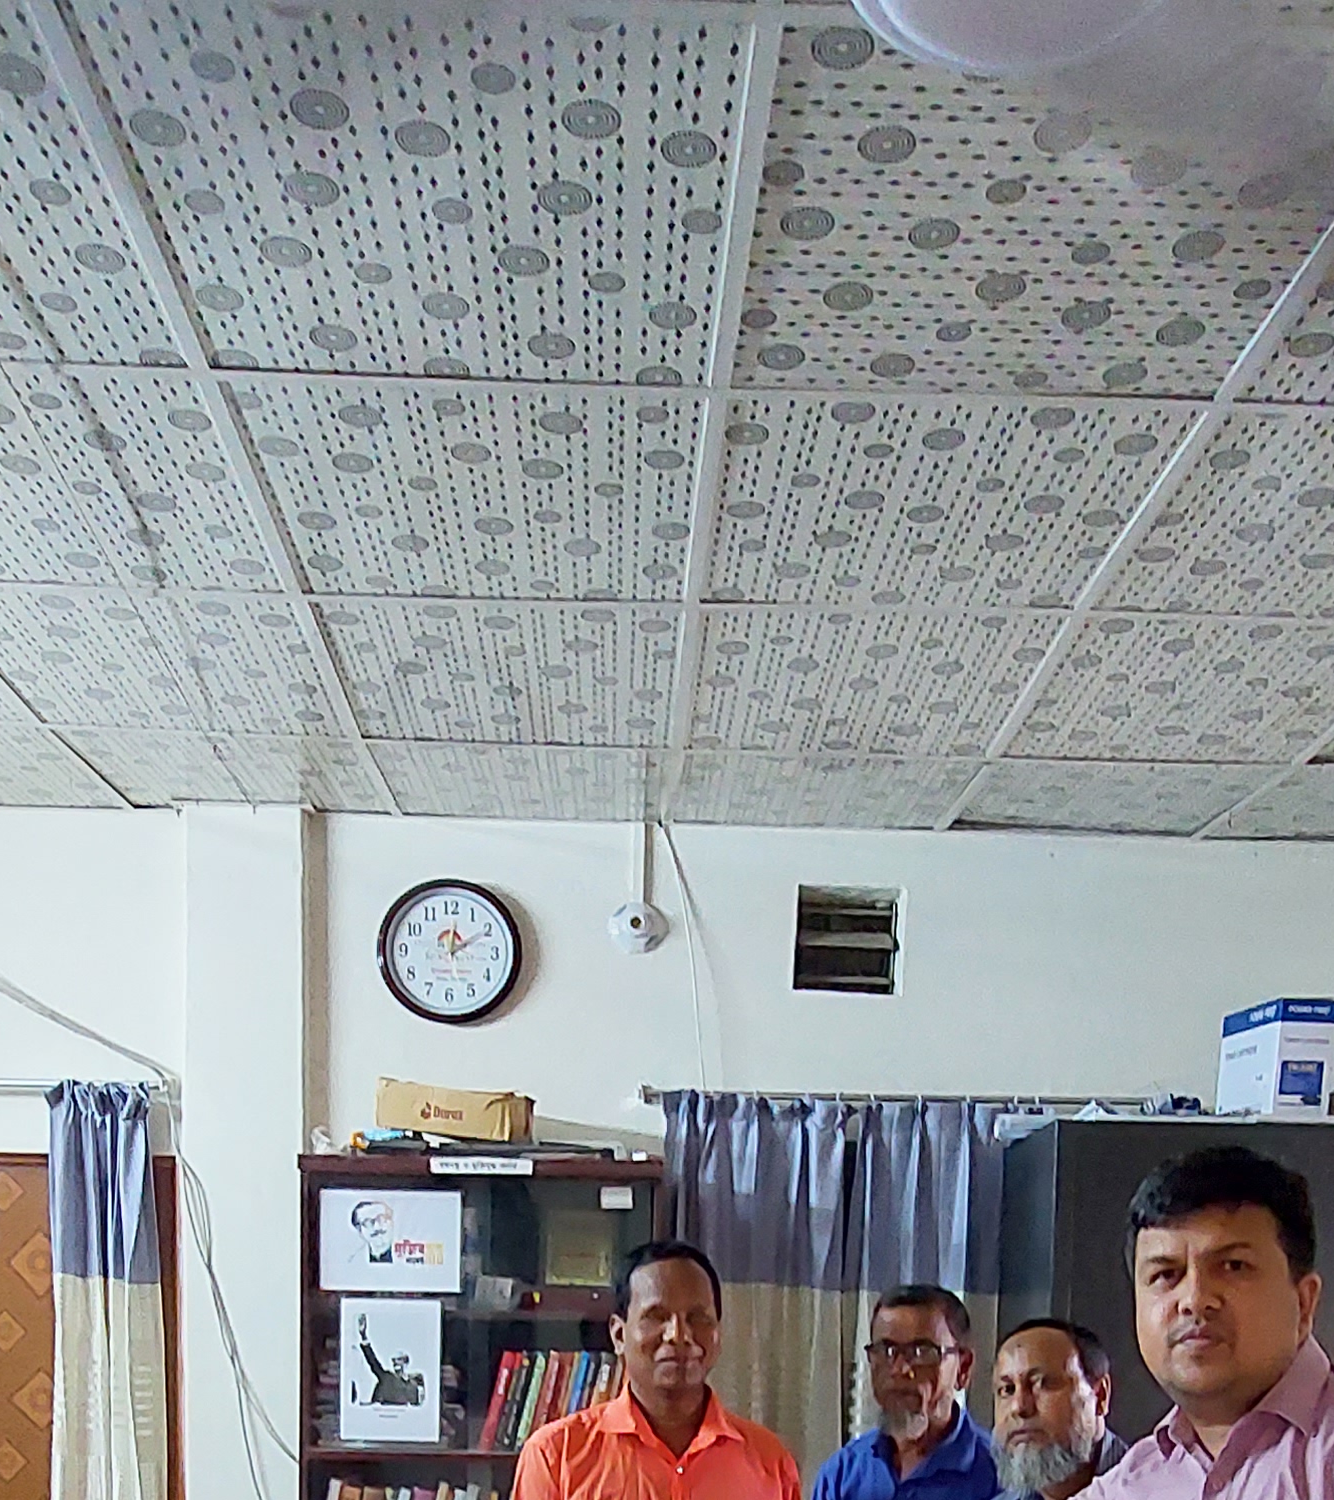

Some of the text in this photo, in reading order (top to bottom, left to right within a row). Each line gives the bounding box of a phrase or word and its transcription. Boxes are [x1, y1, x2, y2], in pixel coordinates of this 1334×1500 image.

[424, 906, 437, 922] 11
[443, 900, 460, 915] 12
[470, 907, 476, 923] 1
[407, 922, 422, 937] 10
[483, 922, 493, 938] 2
[399, 942, 408, 958] 9
[490, 946, 500, 961] 3
[406, 966, 416, 981] 8
[483, 967, 491, 982] 4
[424, 982, 434, 996] 7
[444, 988, 454, 1003] 6
[466, 983, 476, 998] 5
[394, 1239, 425, 1258] মুজিব
